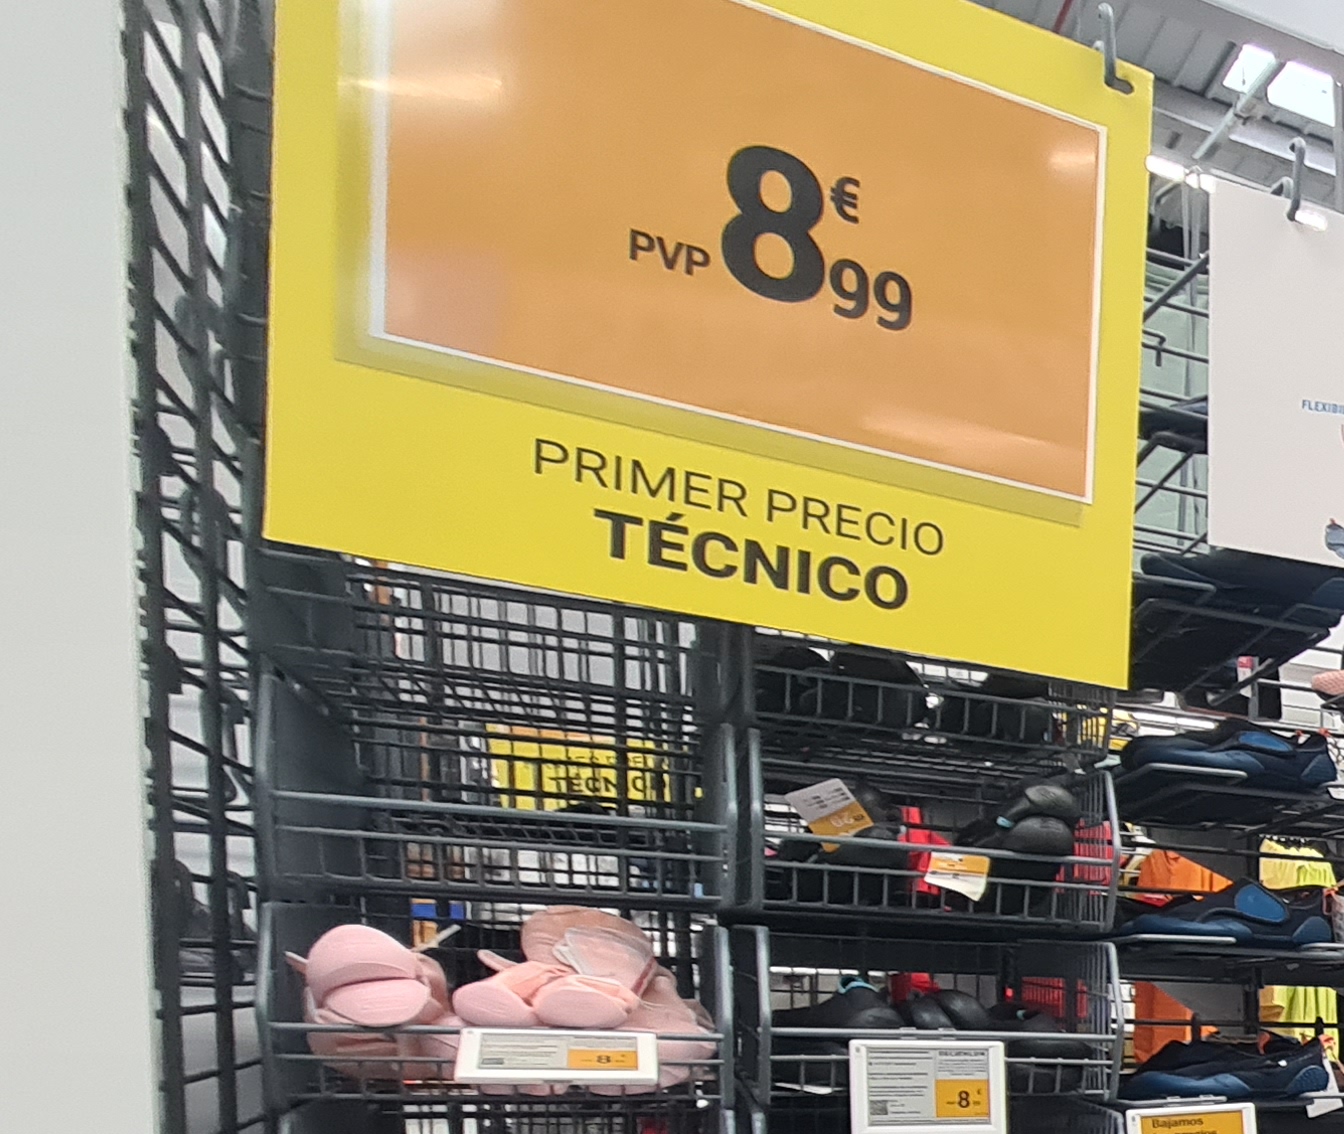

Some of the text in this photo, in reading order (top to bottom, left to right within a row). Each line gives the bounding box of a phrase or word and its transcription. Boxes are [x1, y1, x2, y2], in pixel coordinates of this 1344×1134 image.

[721, 145, 826, 304] 8
[830, 176, 861, 225] €
[628, 227, 711, 277] PVP
[828, 259, 914, 331] 99
[533, 438, 946, 557] PRIMER PRECIO
[592, 508, 911, 612] TÉCNICO
[957, 1090, 970, 1108] 8
[1151, 1118, 1204, 1130] Bajamos
